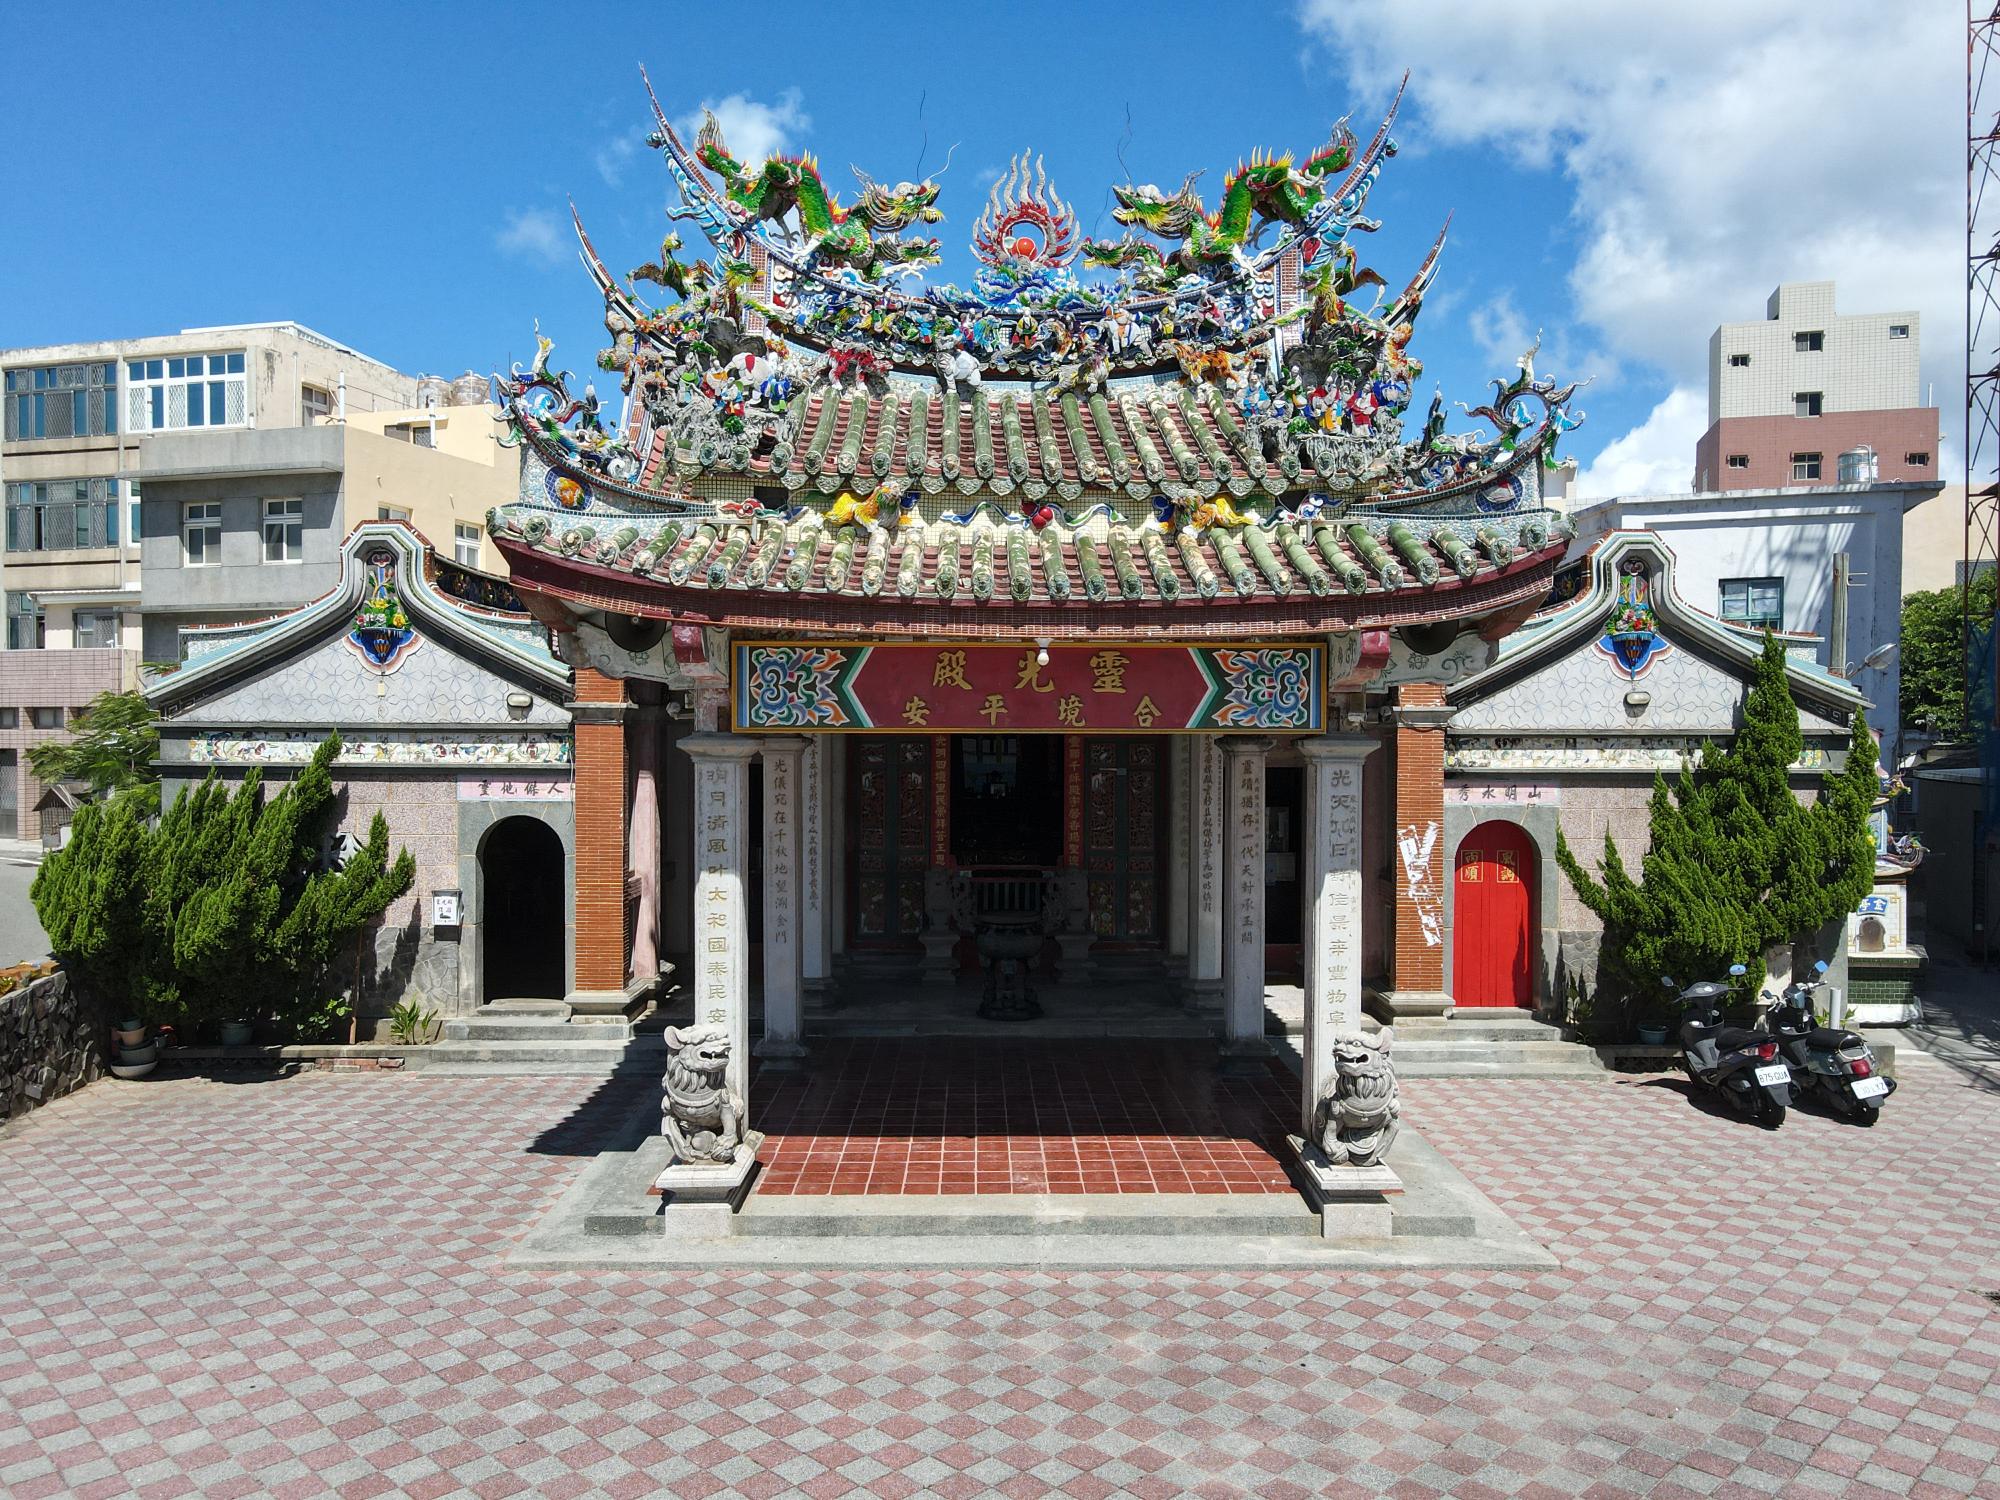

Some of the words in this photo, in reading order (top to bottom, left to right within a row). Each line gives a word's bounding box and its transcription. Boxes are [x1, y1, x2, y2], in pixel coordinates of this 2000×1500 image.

[932, 650, 1132, 693] 靈光殿
[901, 695, 1162, 728] 合境平安
[1458, 784, 1542, 801] 山明水秀
